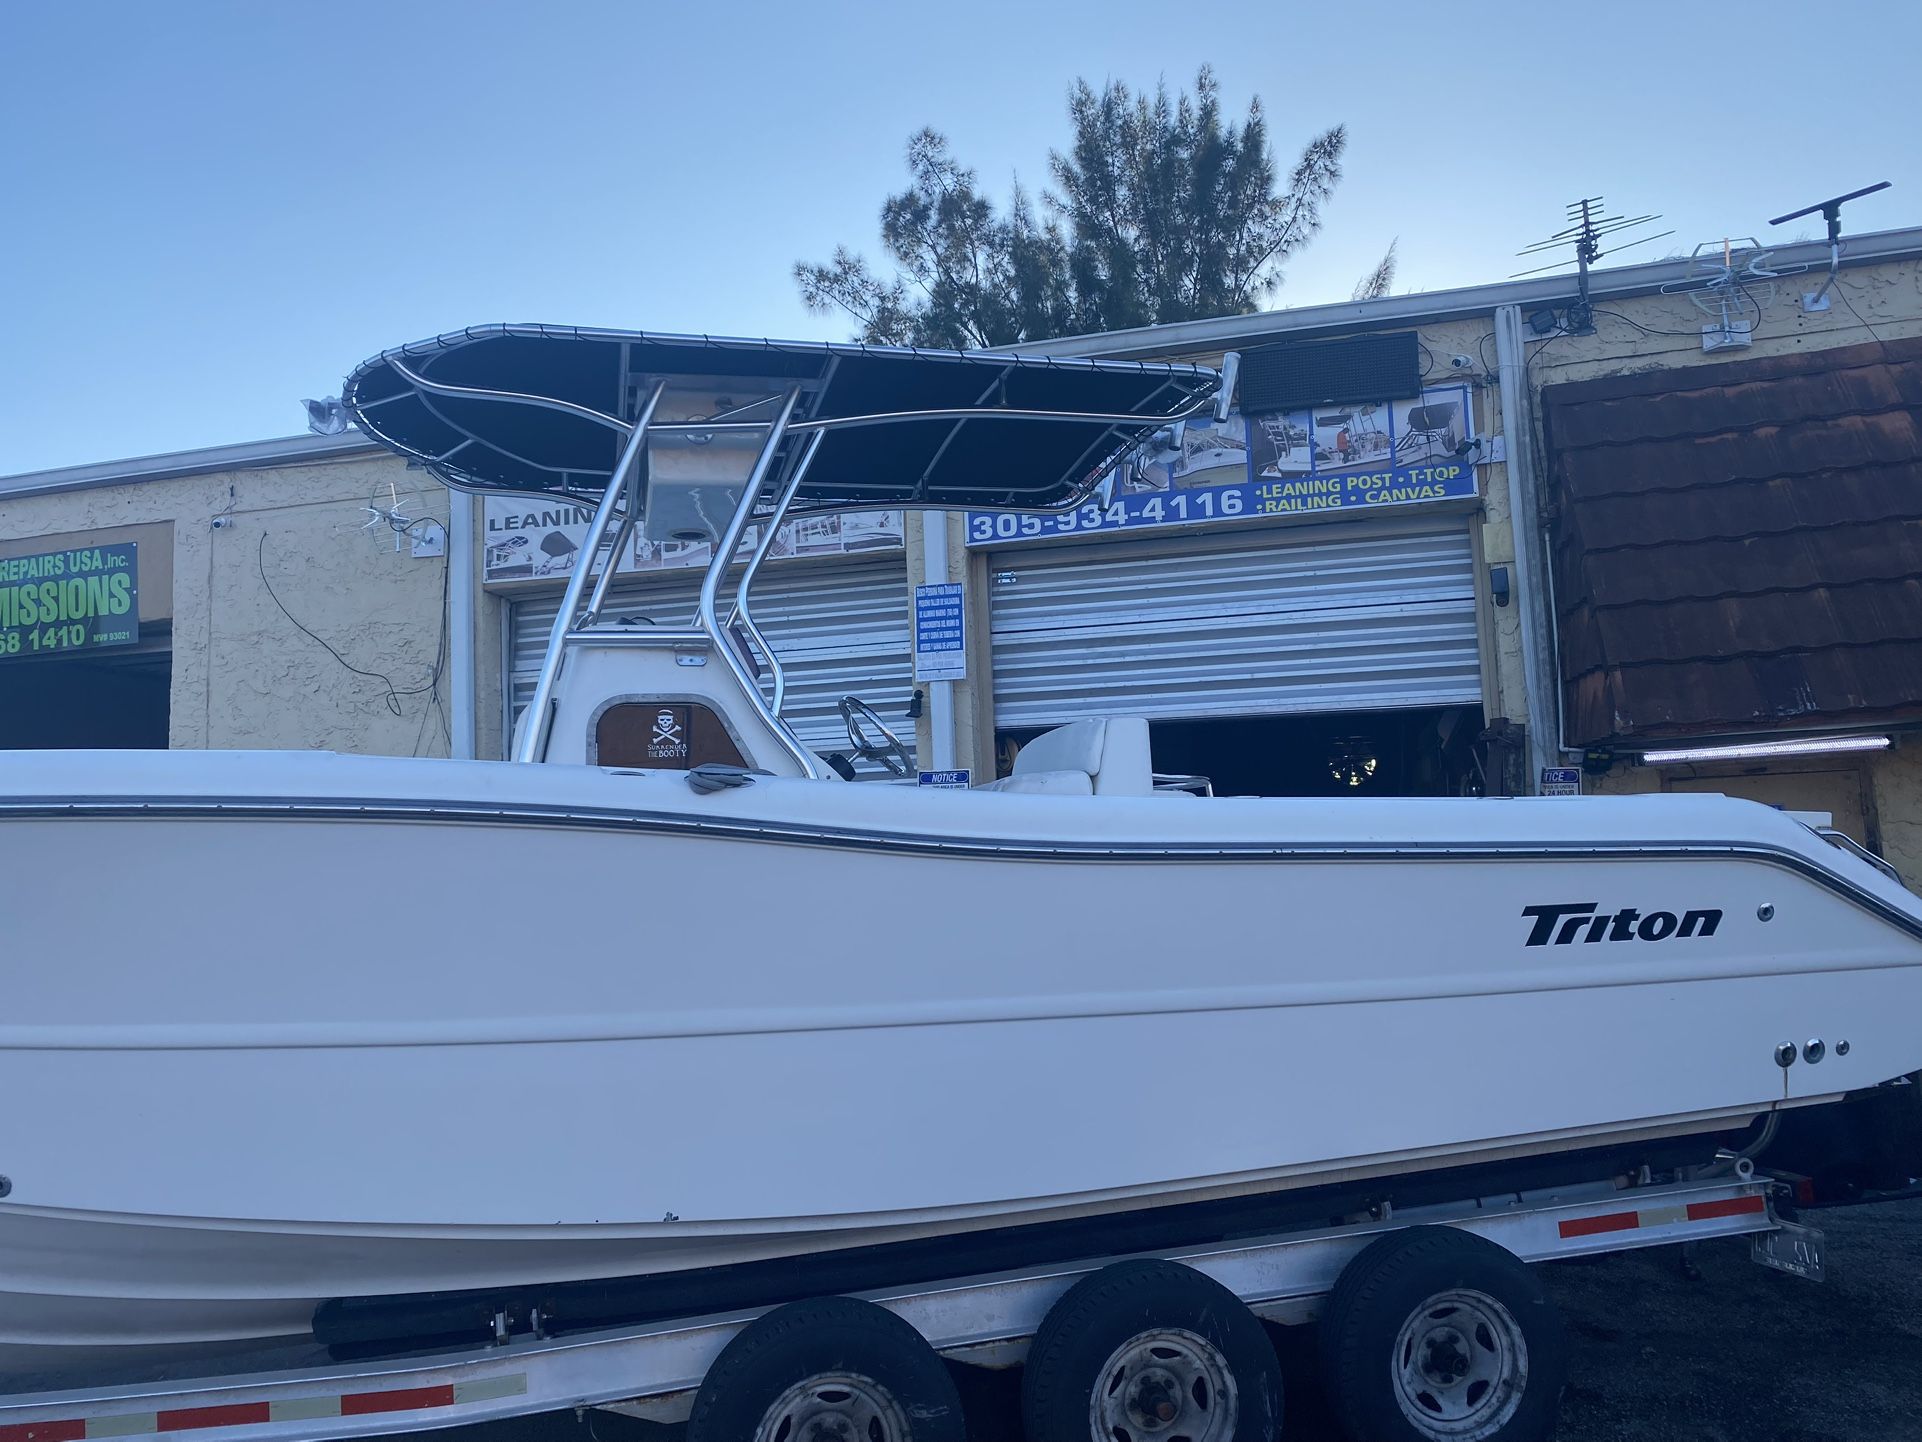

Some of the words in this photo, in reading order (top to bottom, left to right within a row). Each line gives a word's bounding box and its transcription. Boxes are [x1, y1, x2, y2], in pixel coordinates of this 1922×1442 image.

[1262, 478, 1341, 498] LEANING
[1347, 473, 1393, 490] POST
[1409, 466, 1460, 483] T-TOP
[1265, 495, 1342, 513] RAILING
[1365, 484, 1446, 503] CANVAS
[489, 507, 593, 532] LEANIN
[973, 489, 1243, 540] 305-934-4116
[0, 555, 65, 581] REPAIRS
[29, 624, 85, 650] 1410
[109, 631, 130, 642] 93021
[932, 773, 957, 783] NOTICE
[1544, 772, 1564, 781] TICE
[1521, 902, 1723, 947] Triton
